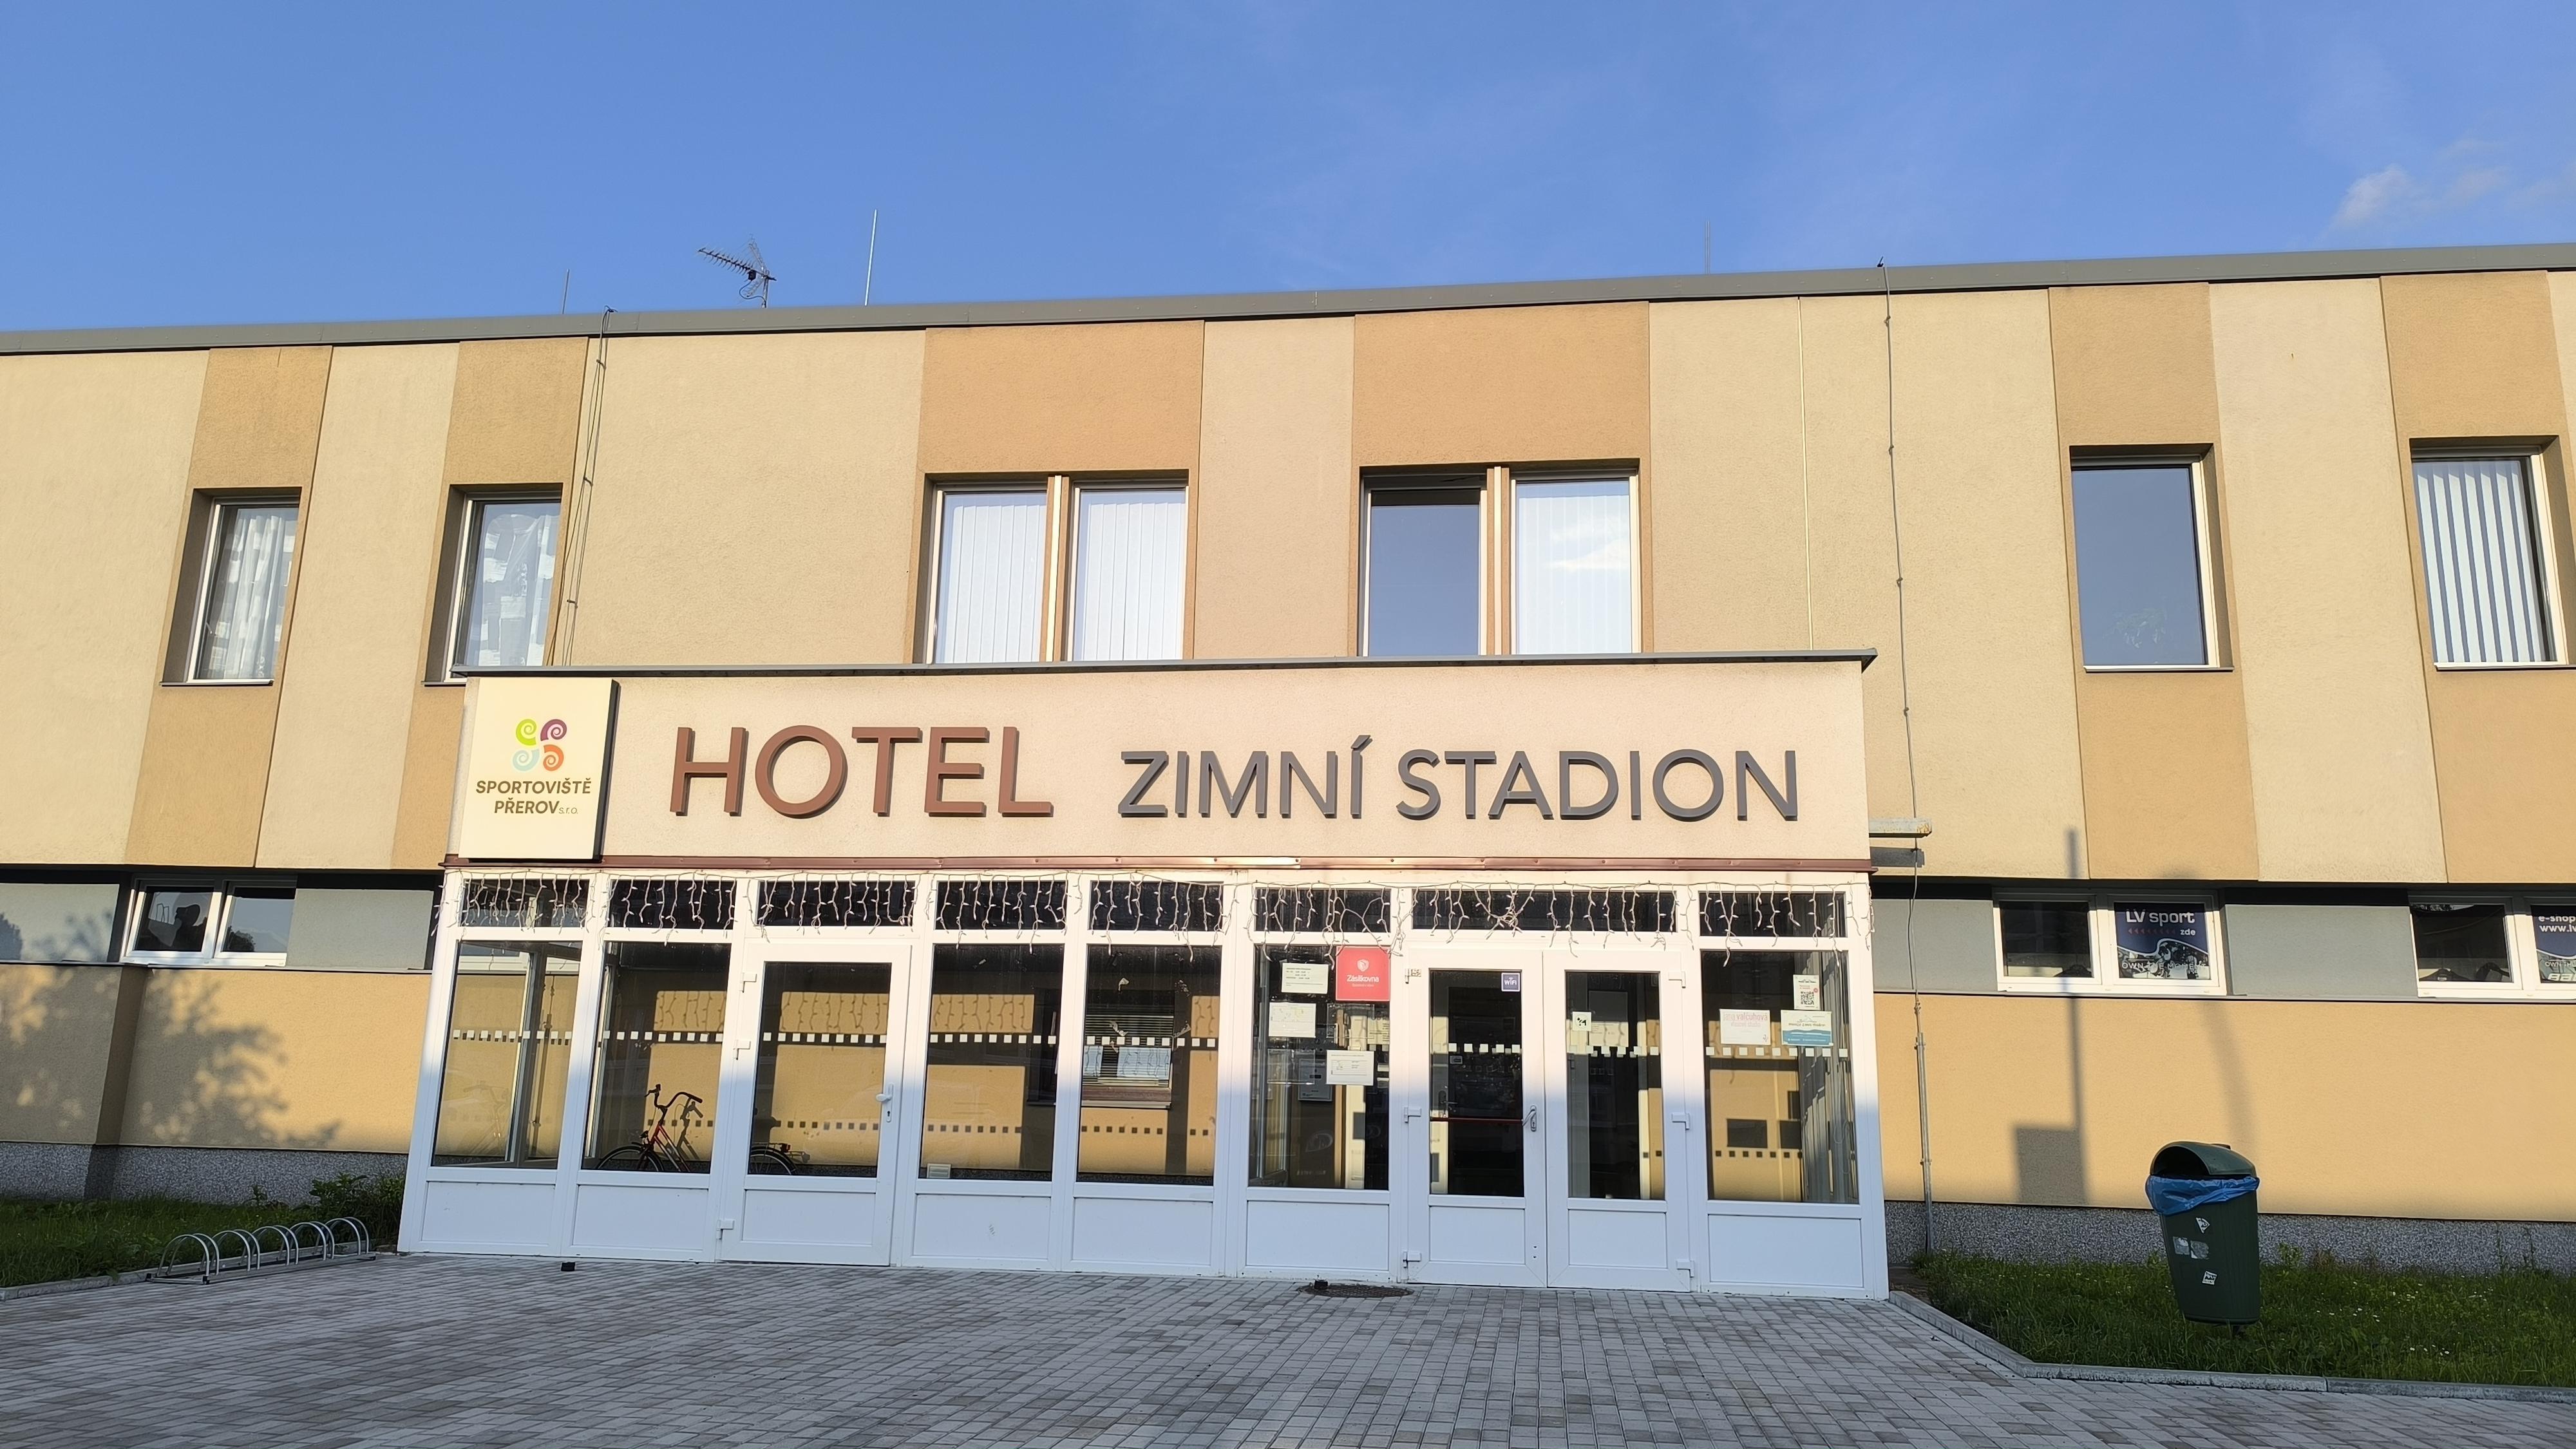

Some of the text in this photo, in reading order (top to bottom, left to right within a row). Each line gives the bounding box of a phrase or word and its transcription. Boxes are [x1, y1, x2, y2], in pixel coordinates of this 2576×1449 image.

[670, 725, 1053, 819] HOTEL
[1118, 735, 1798, 822] ZIMNÍ STADION
[476, 777, 591, 794] SPORTOVIŠTĚ
[494, 797, 560, 814] PŘEROV
[2126, 909, 2195, 927] LV sport
